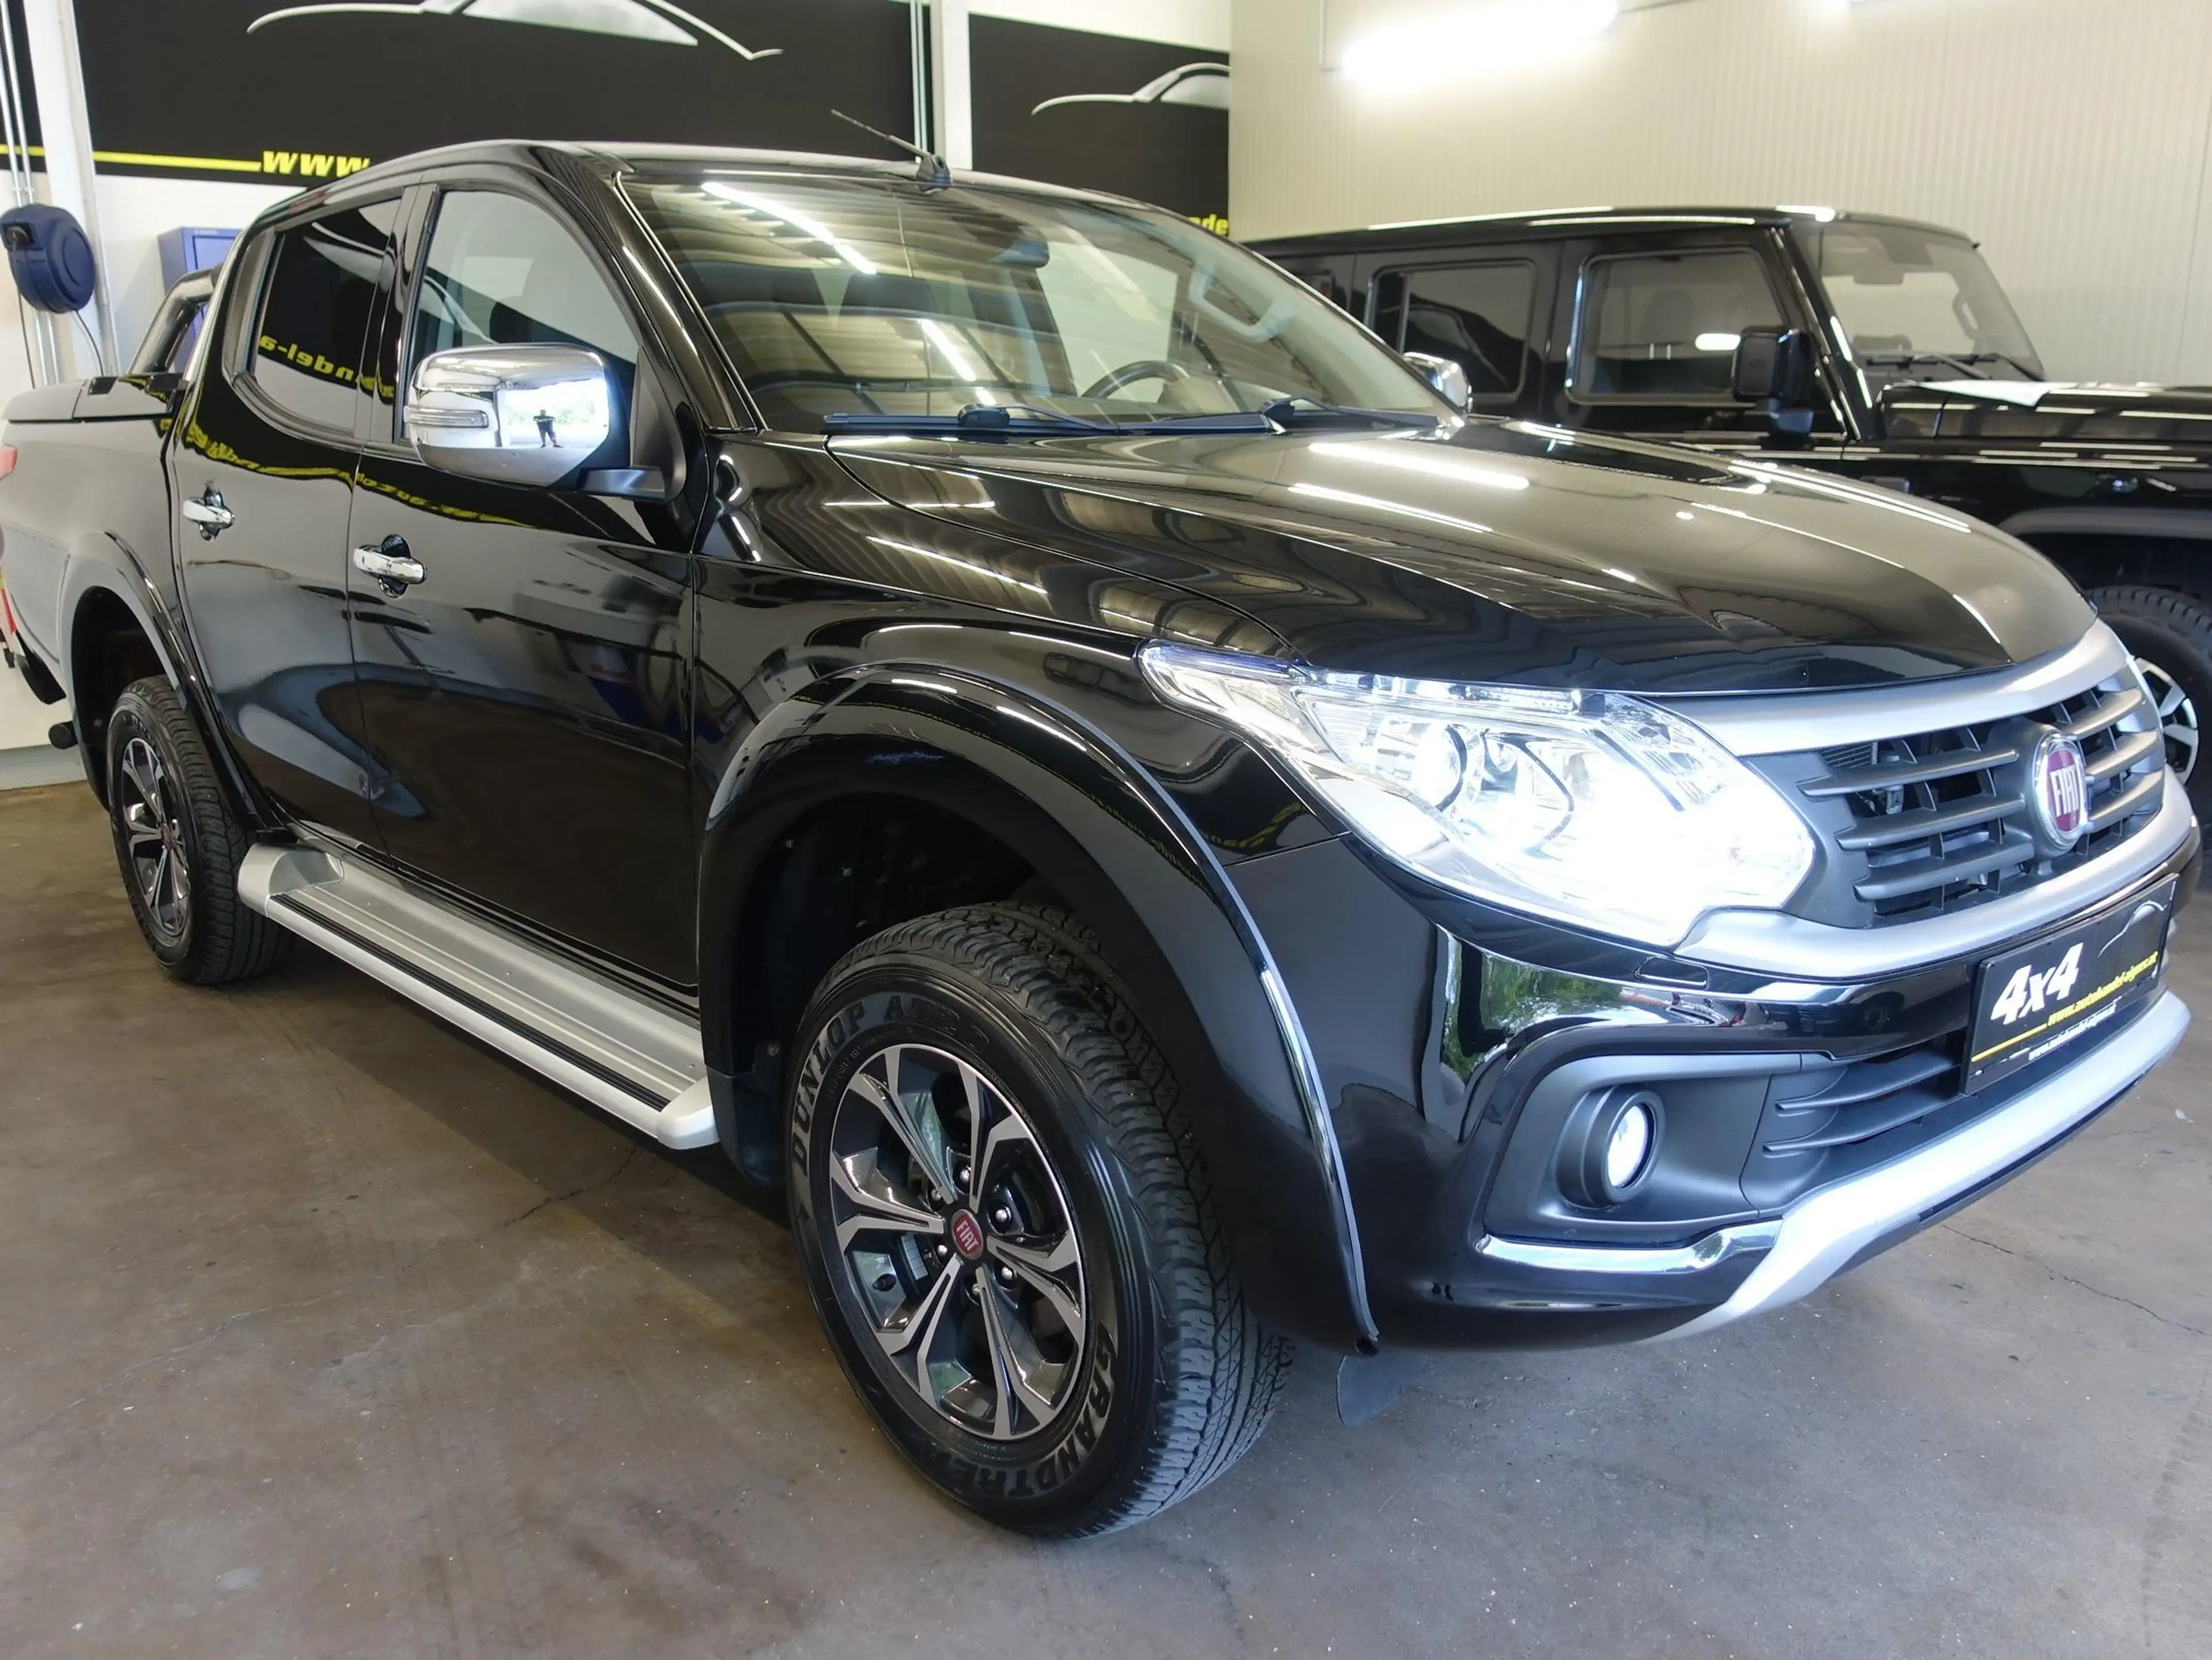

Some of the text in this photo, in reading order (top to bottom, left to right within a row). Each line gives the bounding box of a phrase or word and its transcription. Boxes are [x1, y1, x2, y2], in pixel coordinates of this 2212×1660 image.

[2049, 764, 2079, 817] FIAT
[1990, 942, 2083, 1025] 4x4
[792, 1001, 865, 1177] DUNLOP
[957, 1220, 979, 1251] FIAT
